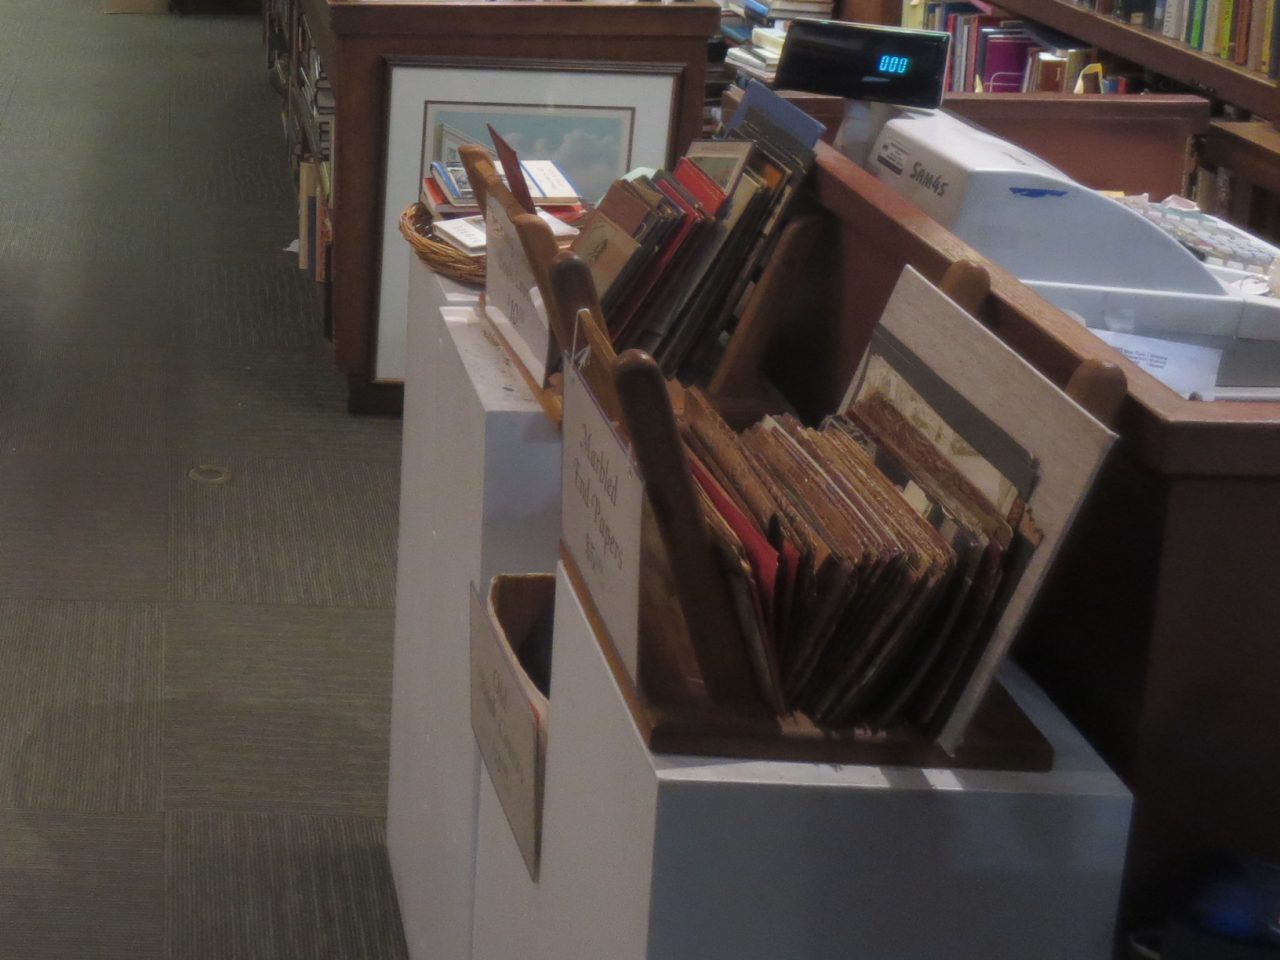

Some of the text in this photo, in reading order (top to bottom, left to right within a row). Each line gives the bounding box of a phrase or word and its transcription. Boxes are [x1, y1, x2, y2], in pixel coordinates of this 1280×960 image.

[574, 458, 624, 569] End Papers
[579, 423, 619, 507] Marbled
